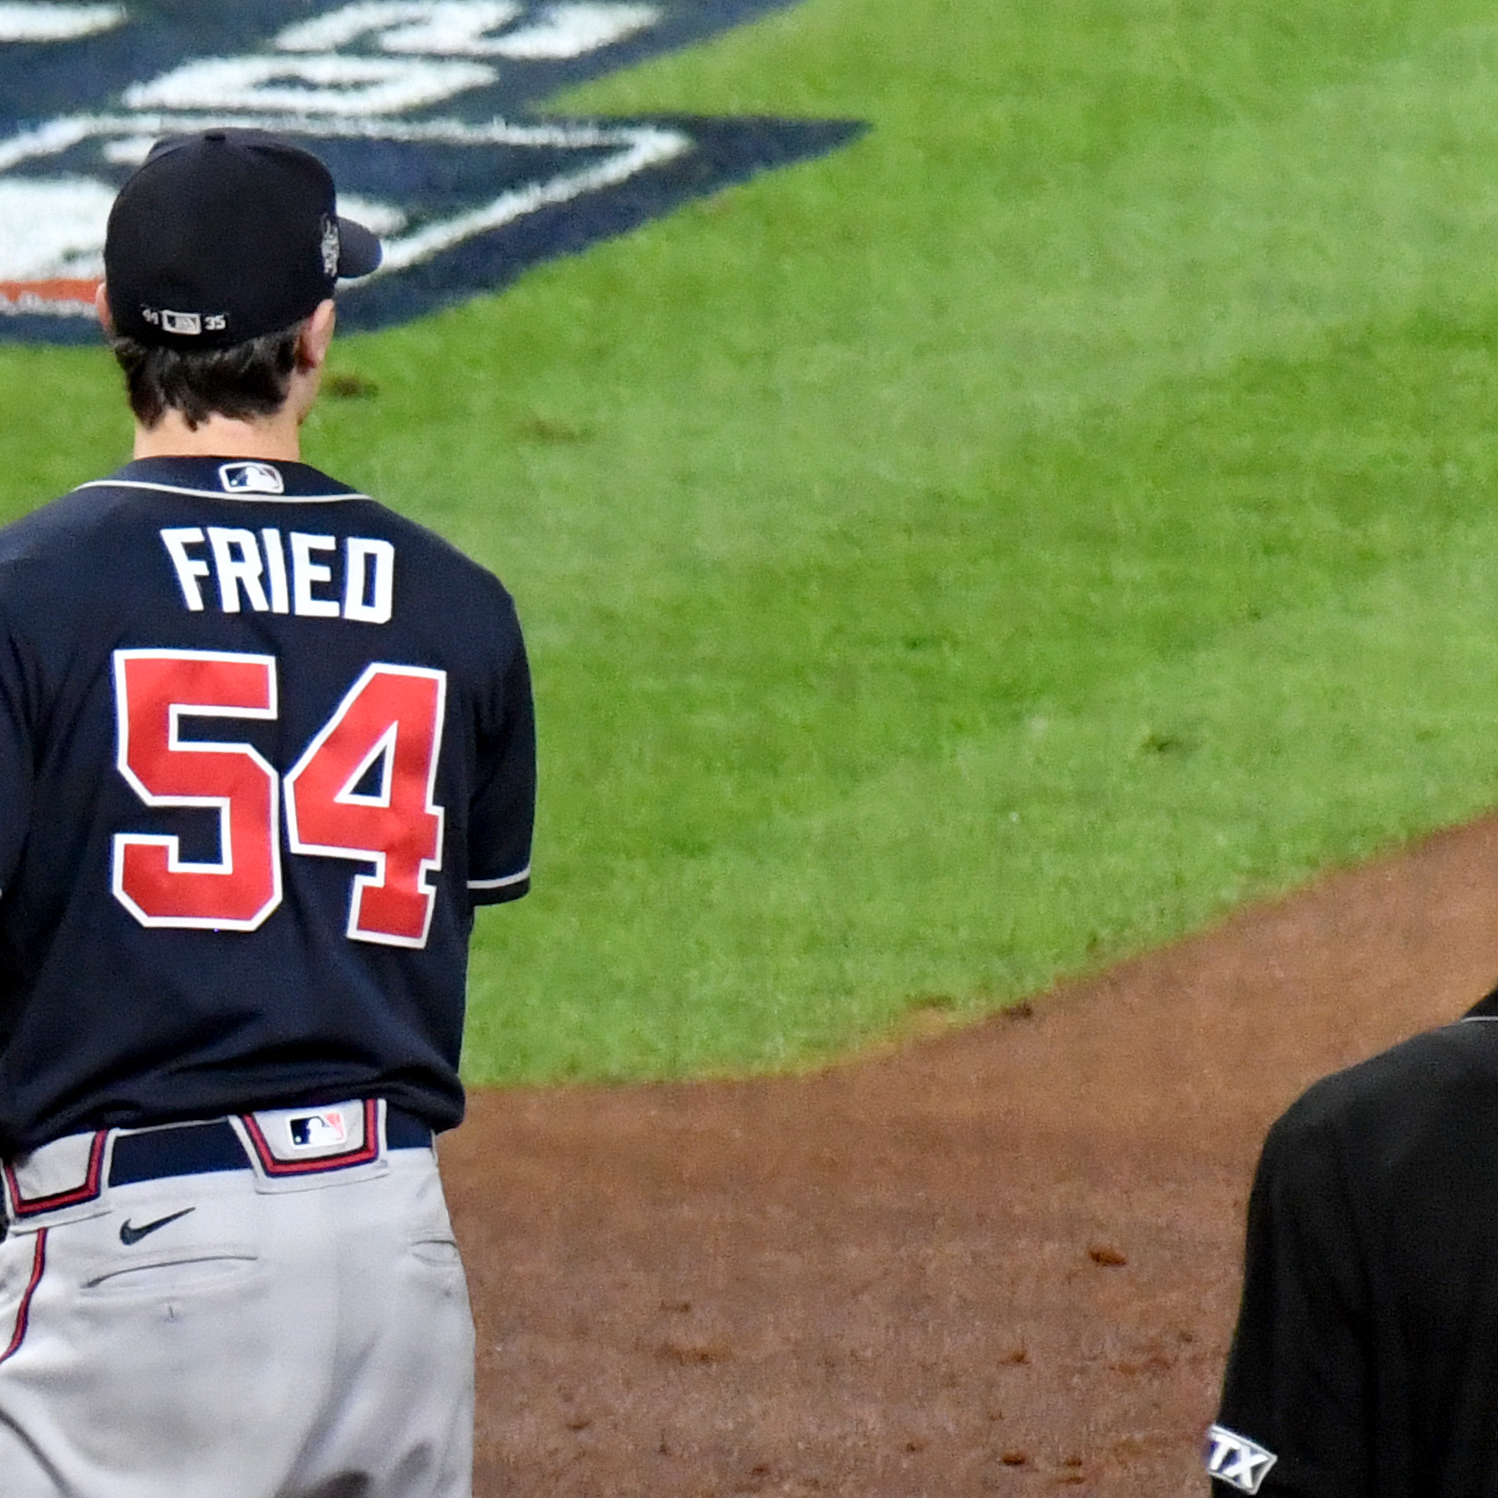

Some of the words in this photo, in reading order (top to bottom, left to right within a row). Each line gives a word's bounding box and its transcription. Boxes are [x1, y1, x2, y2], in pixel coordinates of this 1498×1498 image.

[205, 314, 227, 331] 35
[160, 527, 394, 624] FRIED
[112, 648, 447, 949] 54
[1207, 1433, 1269, 1489] TX
